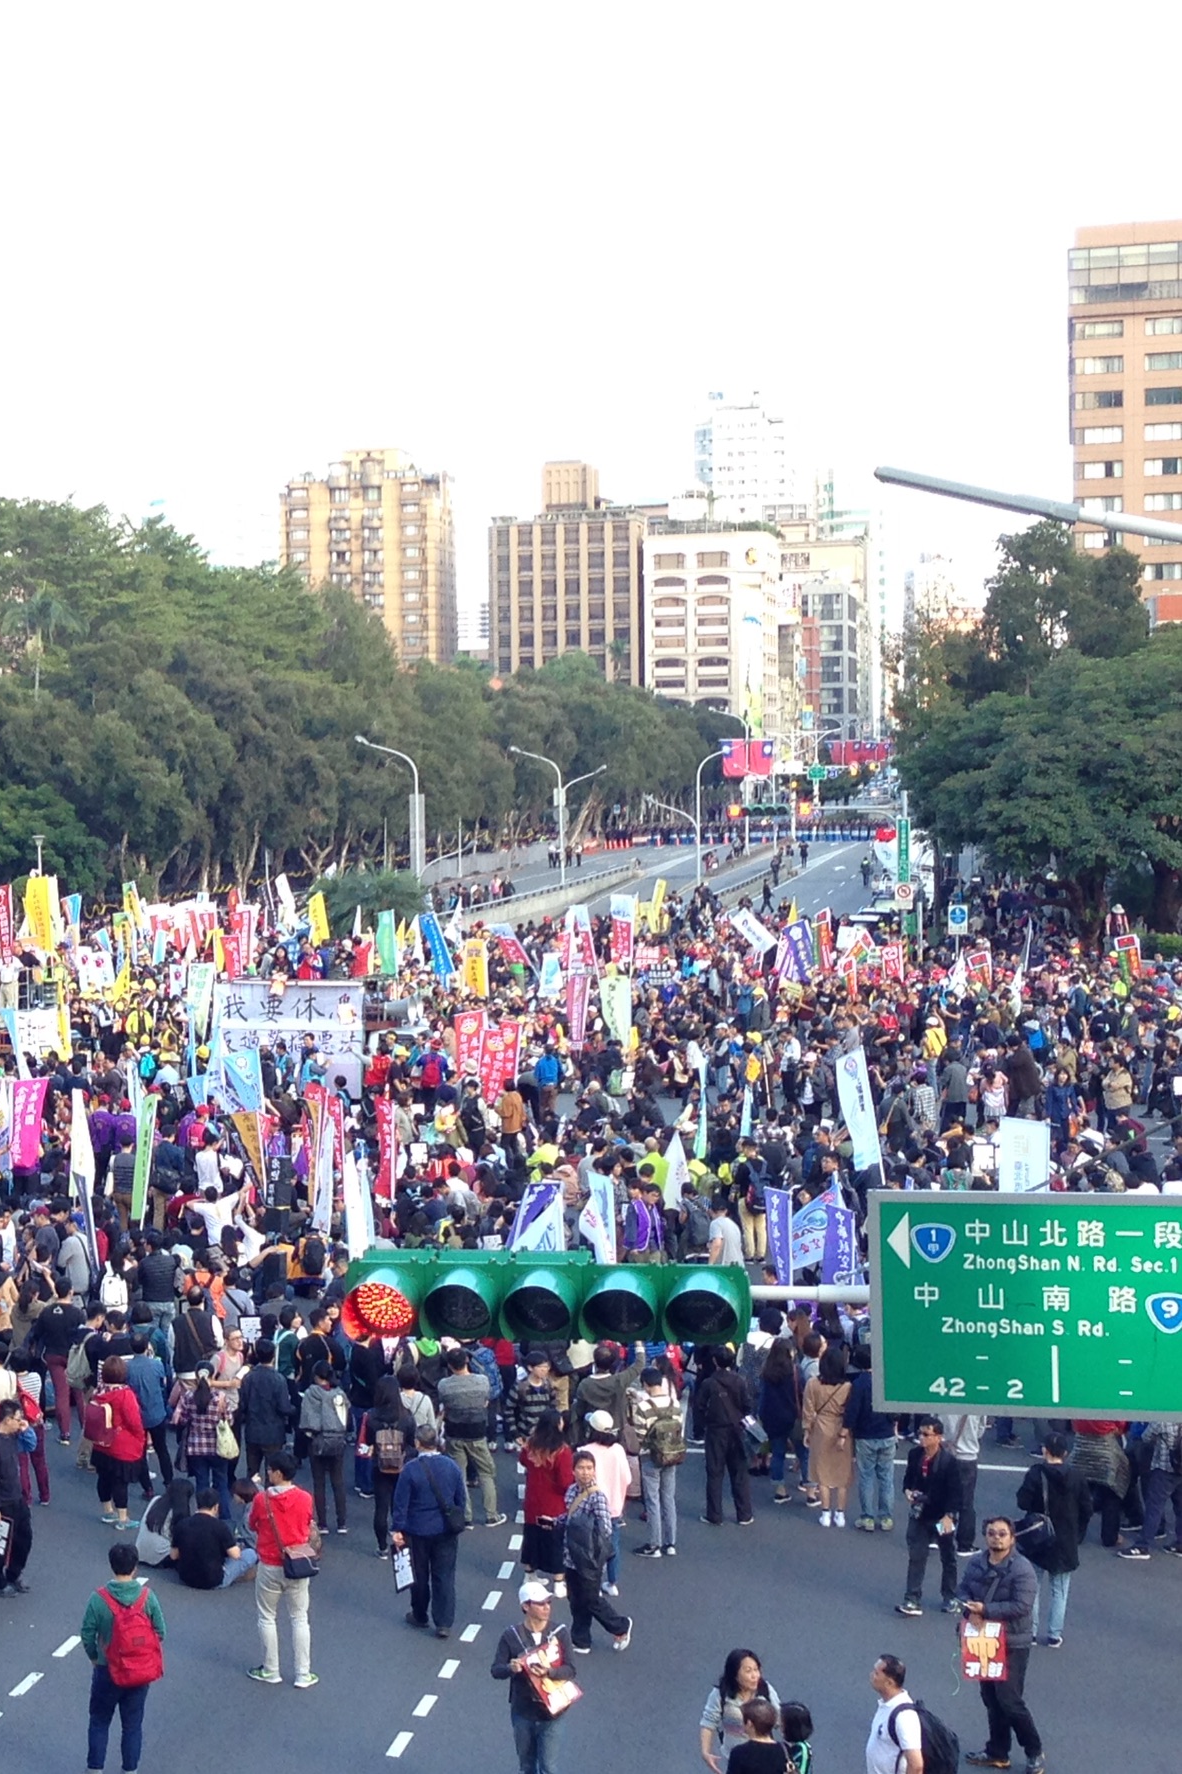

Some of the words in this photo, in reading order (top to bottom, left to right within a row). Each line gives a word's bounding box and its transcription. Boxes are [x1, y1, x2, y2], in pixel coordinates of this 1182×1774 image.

[930, 1228, 936, 1242] 1
[965, 1218, 1182, 1249] 中山北路一段
[963, 1253, 1061, 1275] ZhongShan
[1093, 1256, 1122, 1273] Rd.
[914, 1282, 1138, 1314] 中山南路
[1161, 1300, 1179, 1319] 9
[941, 1317, 1045, 1338] ZhongShan
[1077, 1320, 1110, 1337] Rd.
